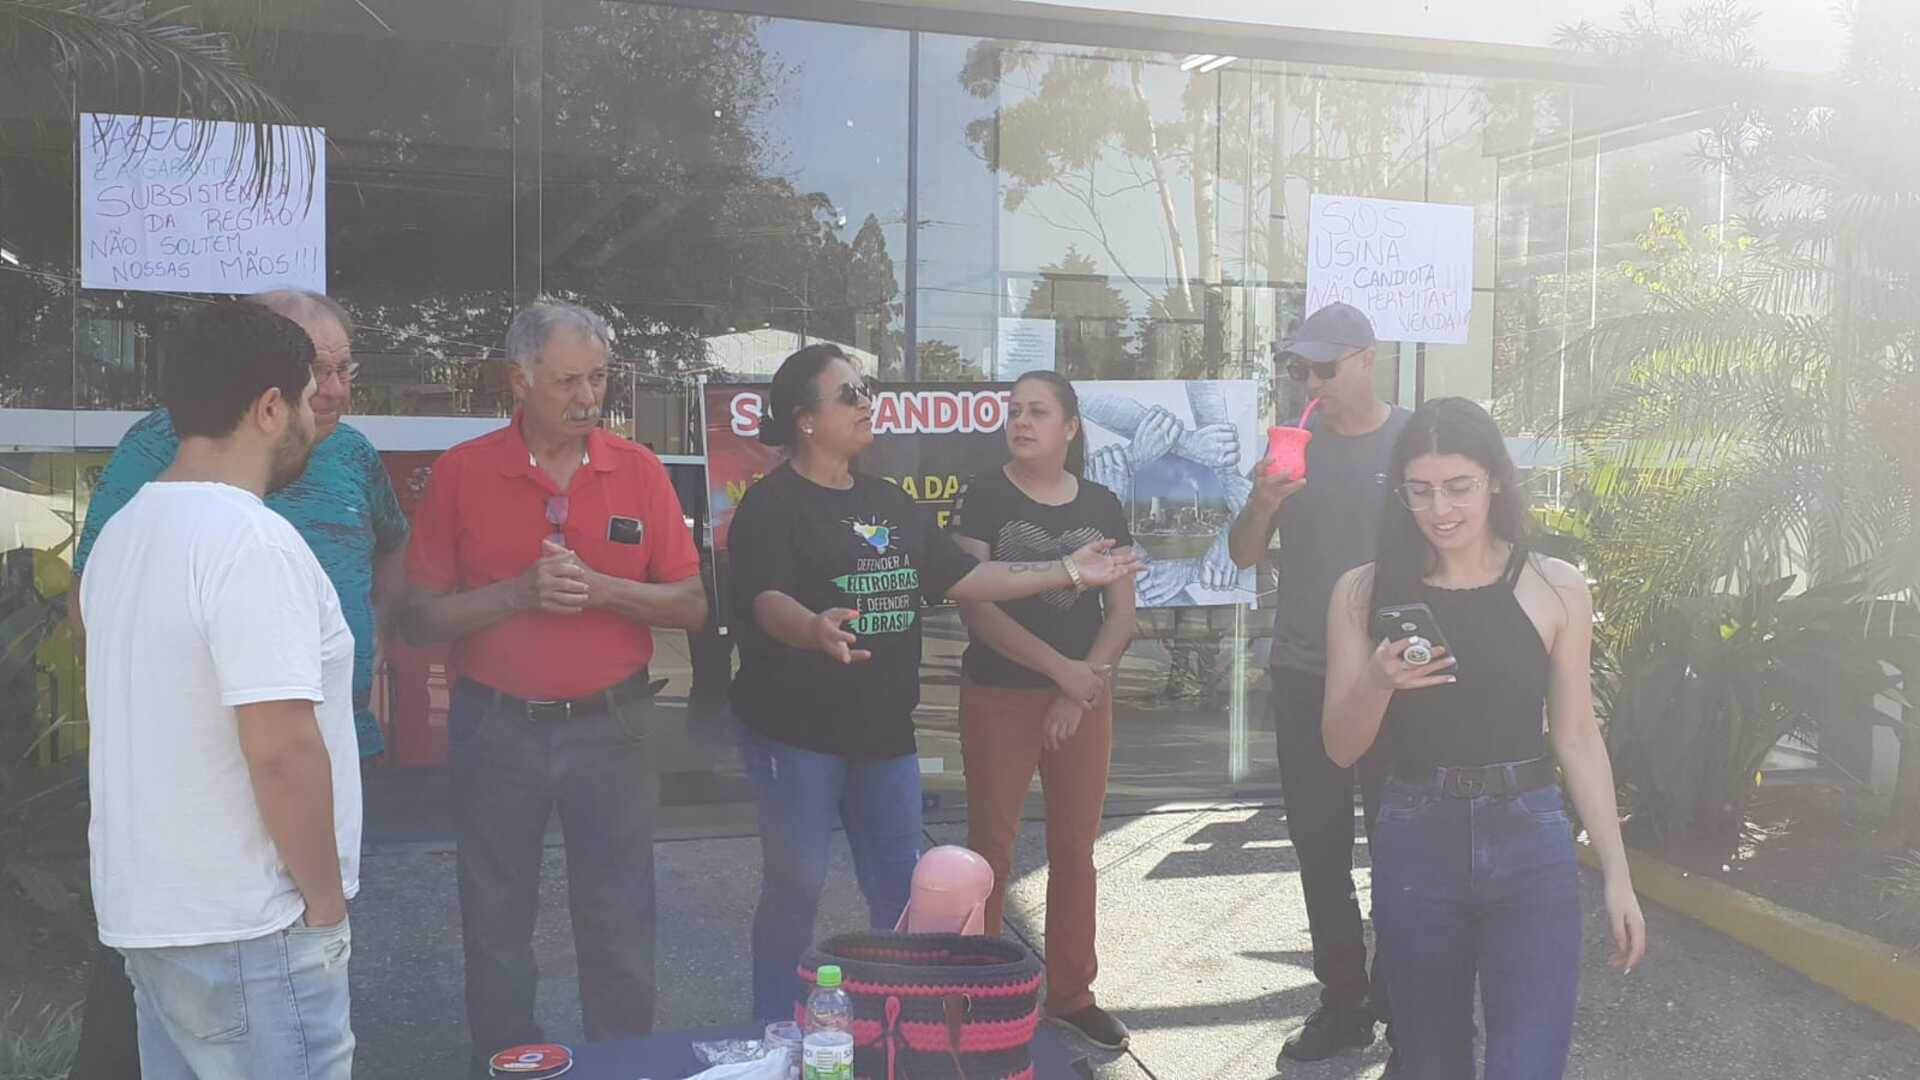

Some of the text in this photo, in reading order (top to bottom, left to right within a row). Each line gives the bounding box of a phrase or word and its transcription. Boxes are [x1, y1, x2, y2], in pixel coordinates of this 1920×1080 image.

[144, 214, 176, 234] DA
[1320, 201, 1408, 239] SOS
[90, 227, 137, 259] NÃO
[1315, 233, 1401, 269] USINA
[112, 261, 191, 283] NOSSAS
[1308, 273, 1353, 312] NÃO
[857, 553, 911, 571] DEFENDER A
[847, 572, 920, 592] ELETROBRAS
[867, 594, 911, 612] DEFENDER
[858, 617, 868, 632] O
